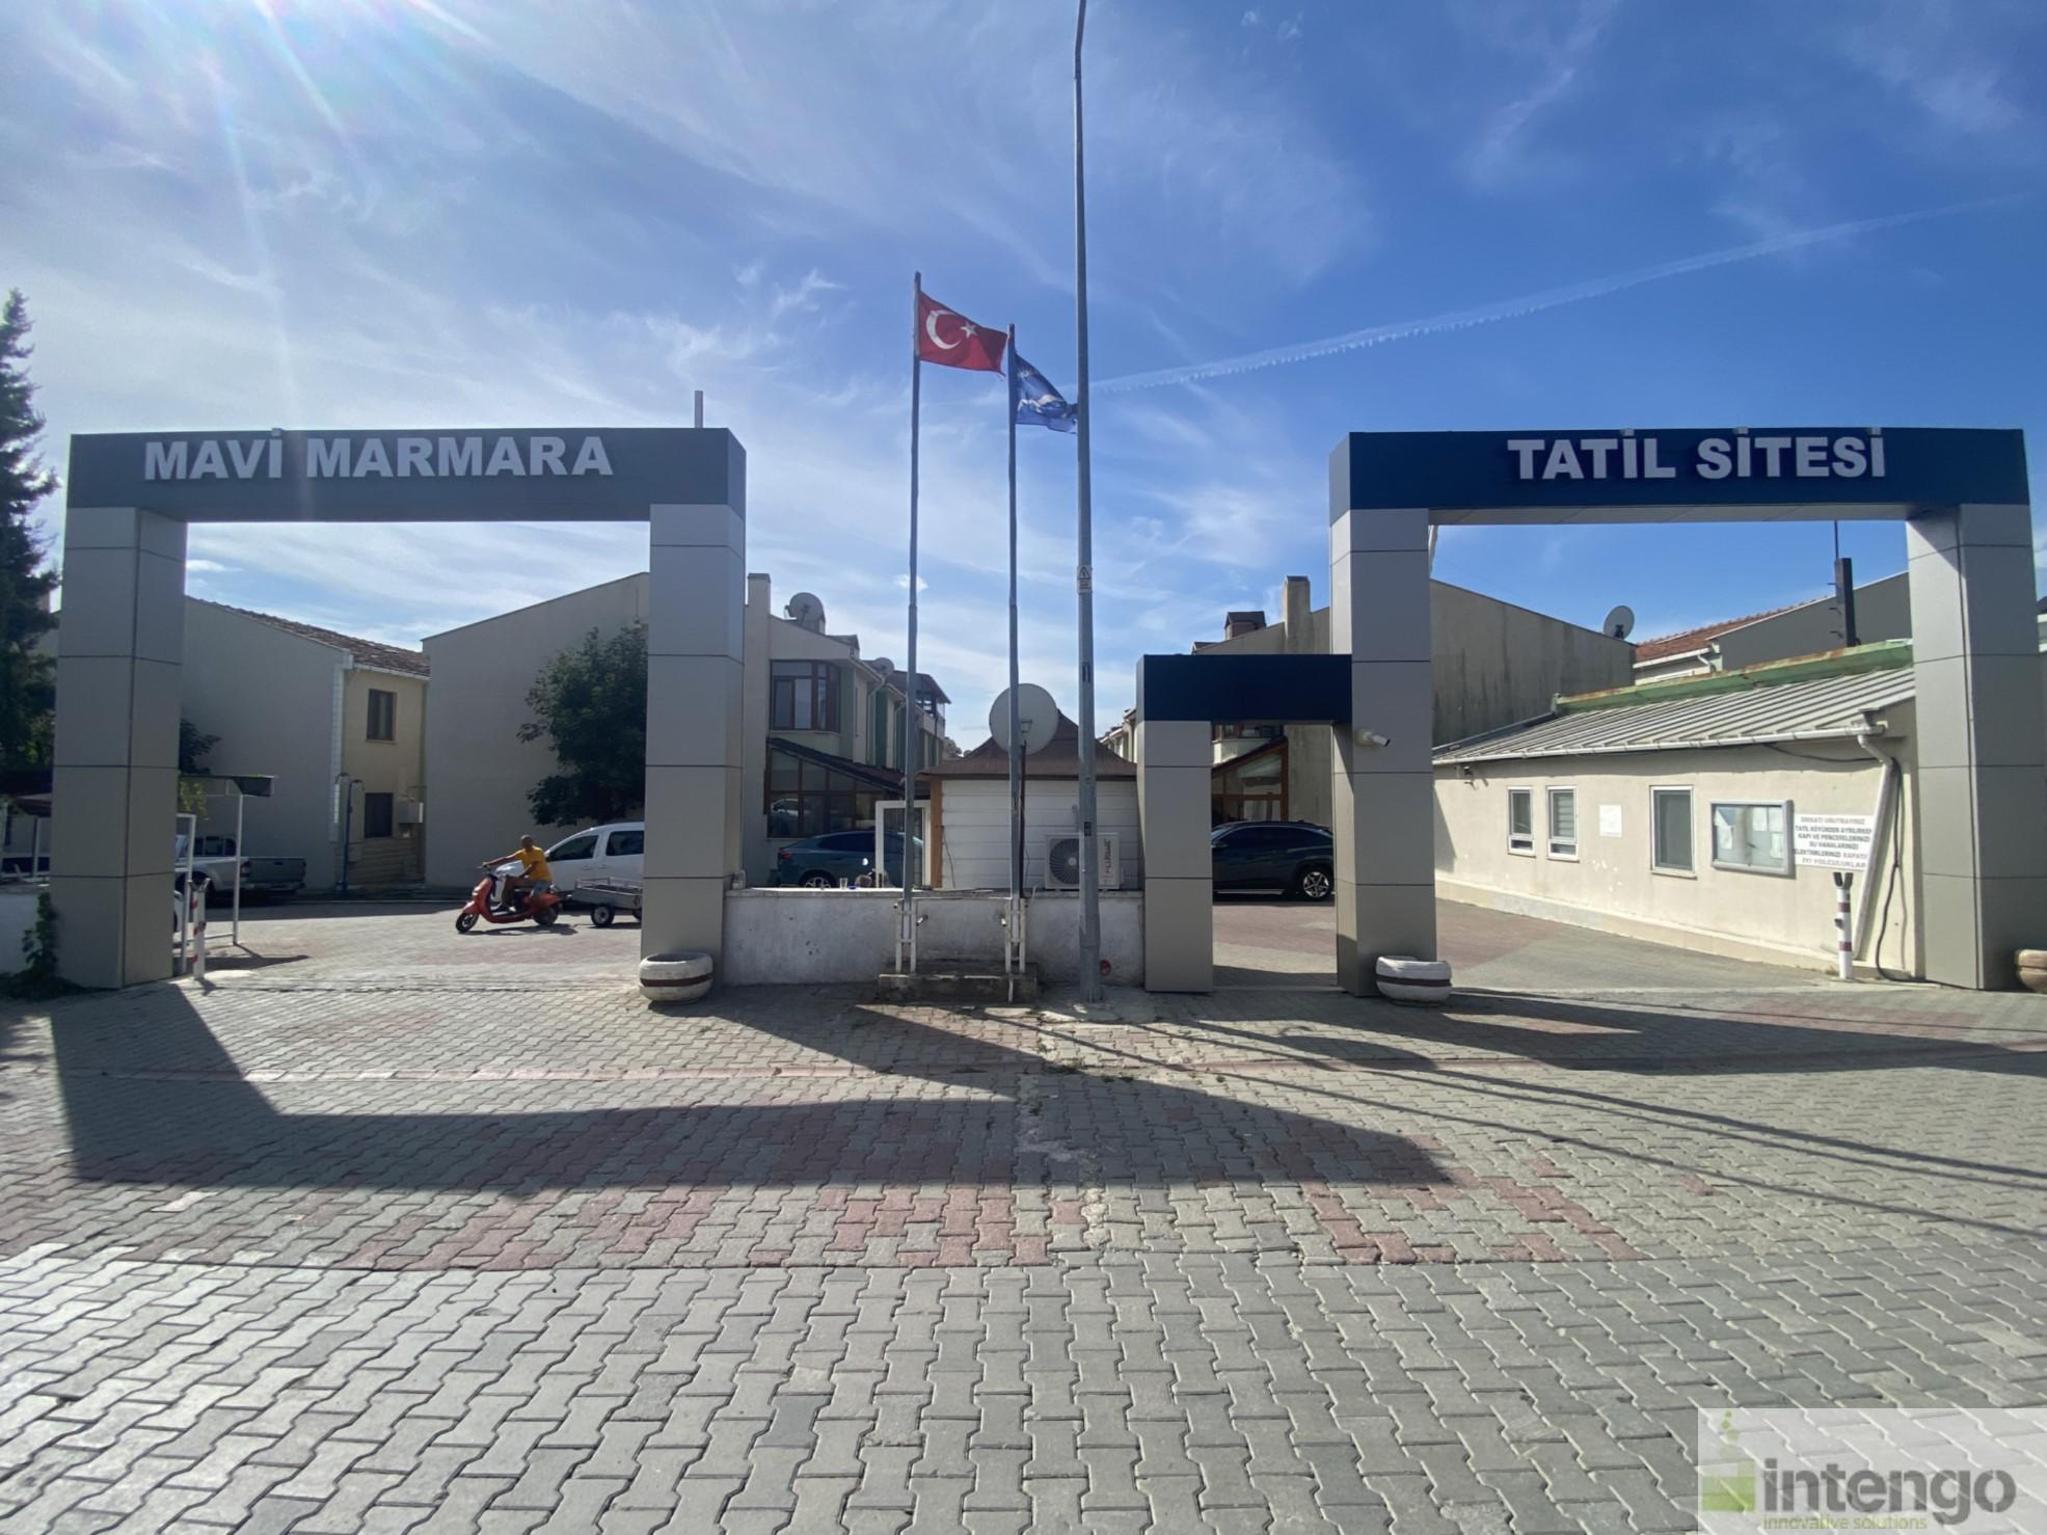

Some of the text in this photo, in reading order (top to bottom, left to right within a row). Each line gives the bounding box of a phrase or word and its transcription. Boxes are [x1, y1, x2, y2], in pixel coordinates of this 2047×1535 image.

[144, 428, 613, 480] MAVİ MARMARA
[1507, 427, 1886, 480] TATİL SİTESİ
